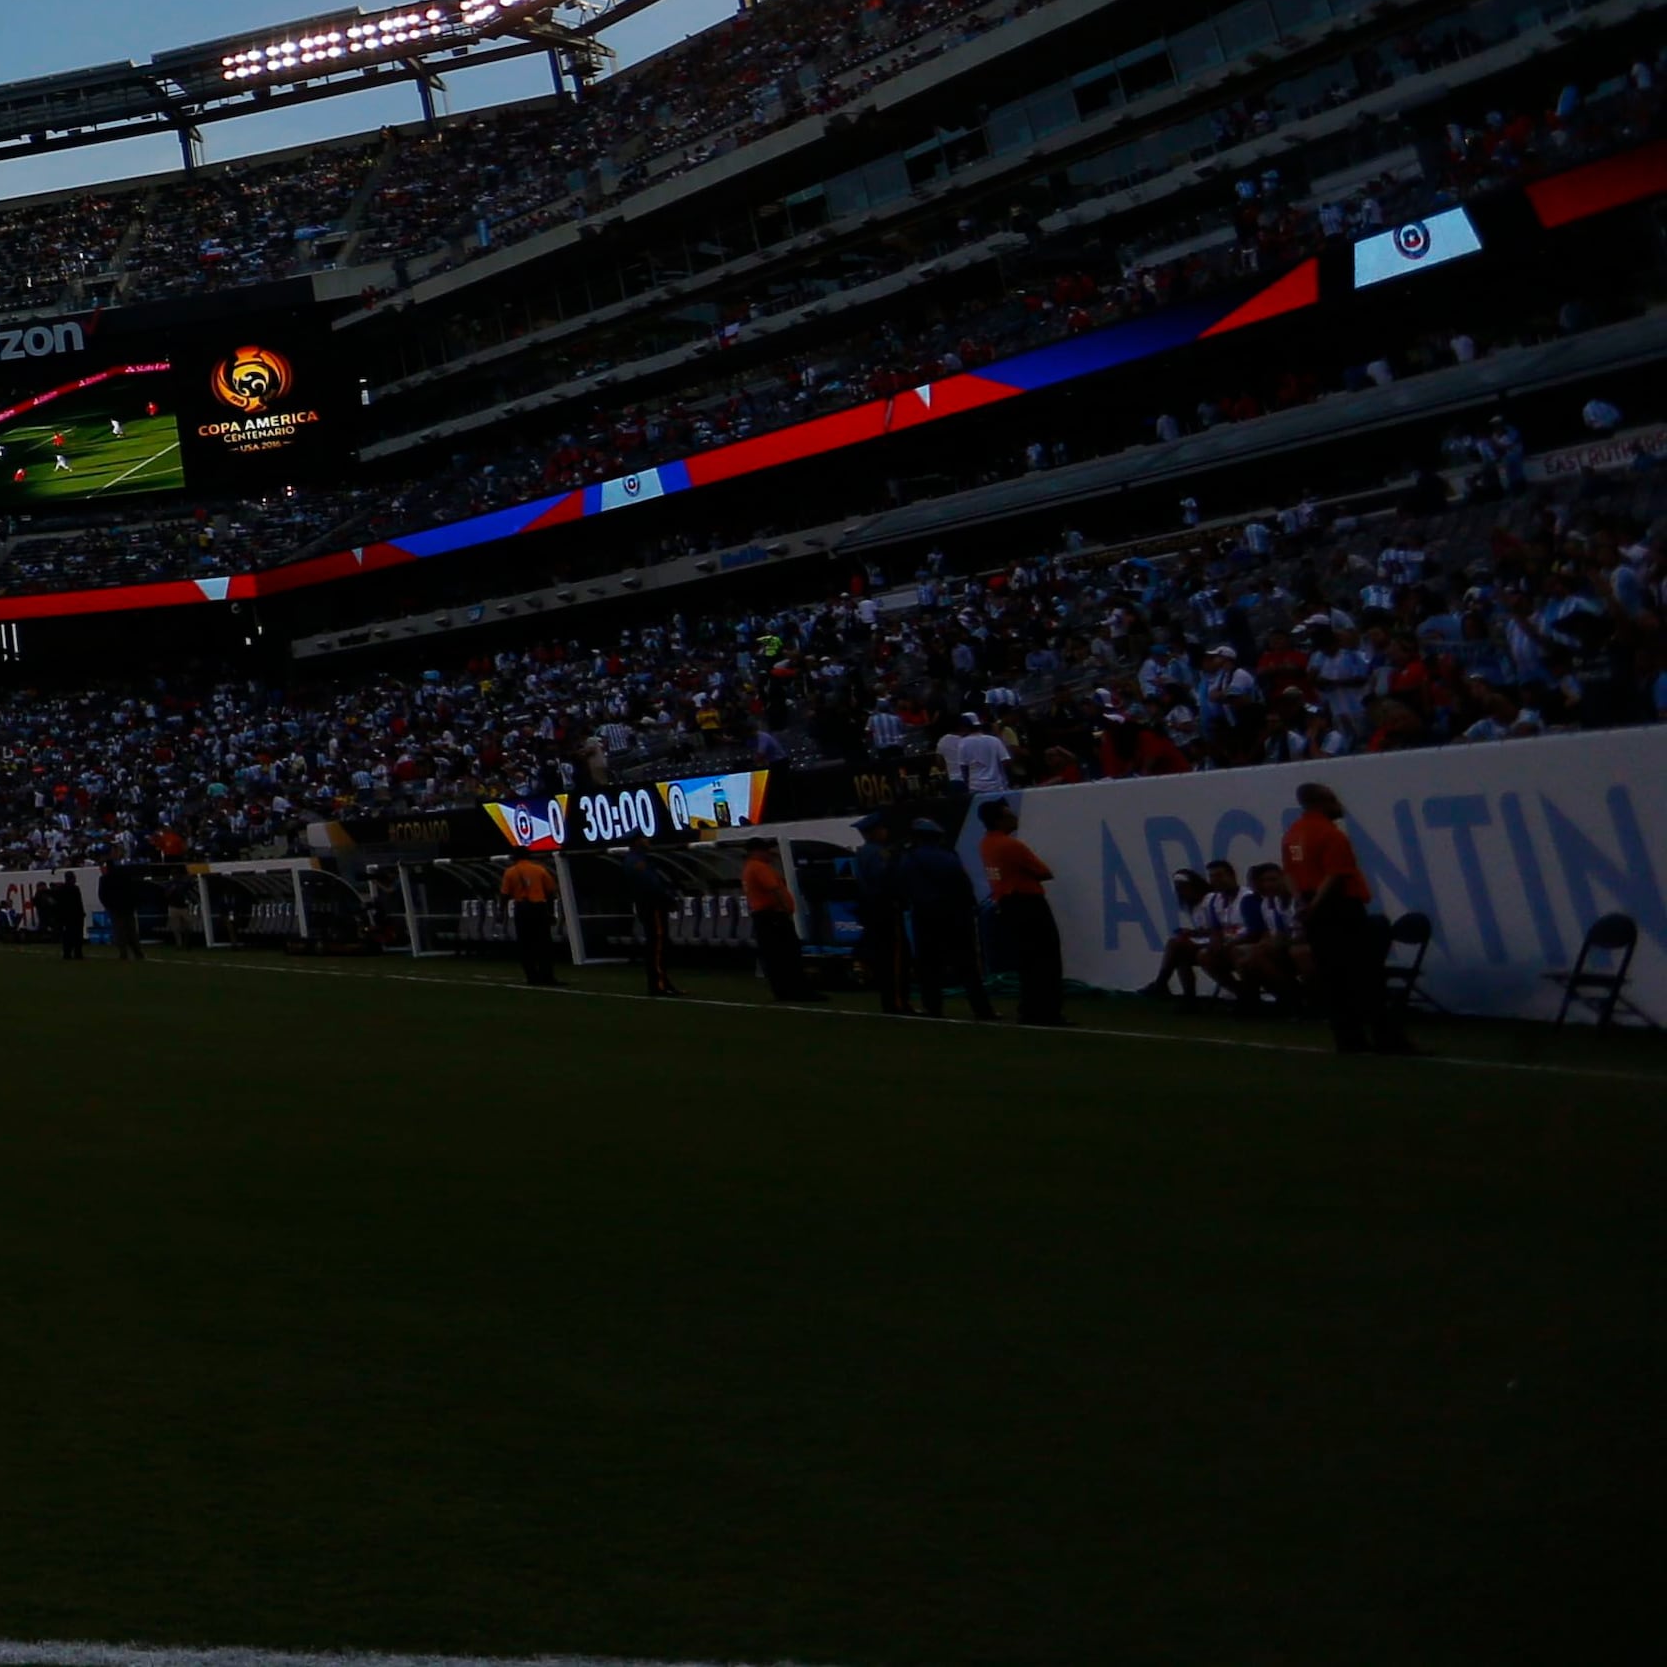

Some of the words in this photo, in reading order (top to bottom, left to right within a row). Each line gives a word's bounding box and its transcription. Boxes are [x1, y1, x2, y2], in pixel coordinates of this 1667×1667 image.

[198, 421, 241, 437] COPA
[244, 409, 321, 431] AMERICA
[223, 426, 295, 443] CENTENARIO
[240, 443, 259, 452] USA
[578, 788, 658, 843] 30:00
